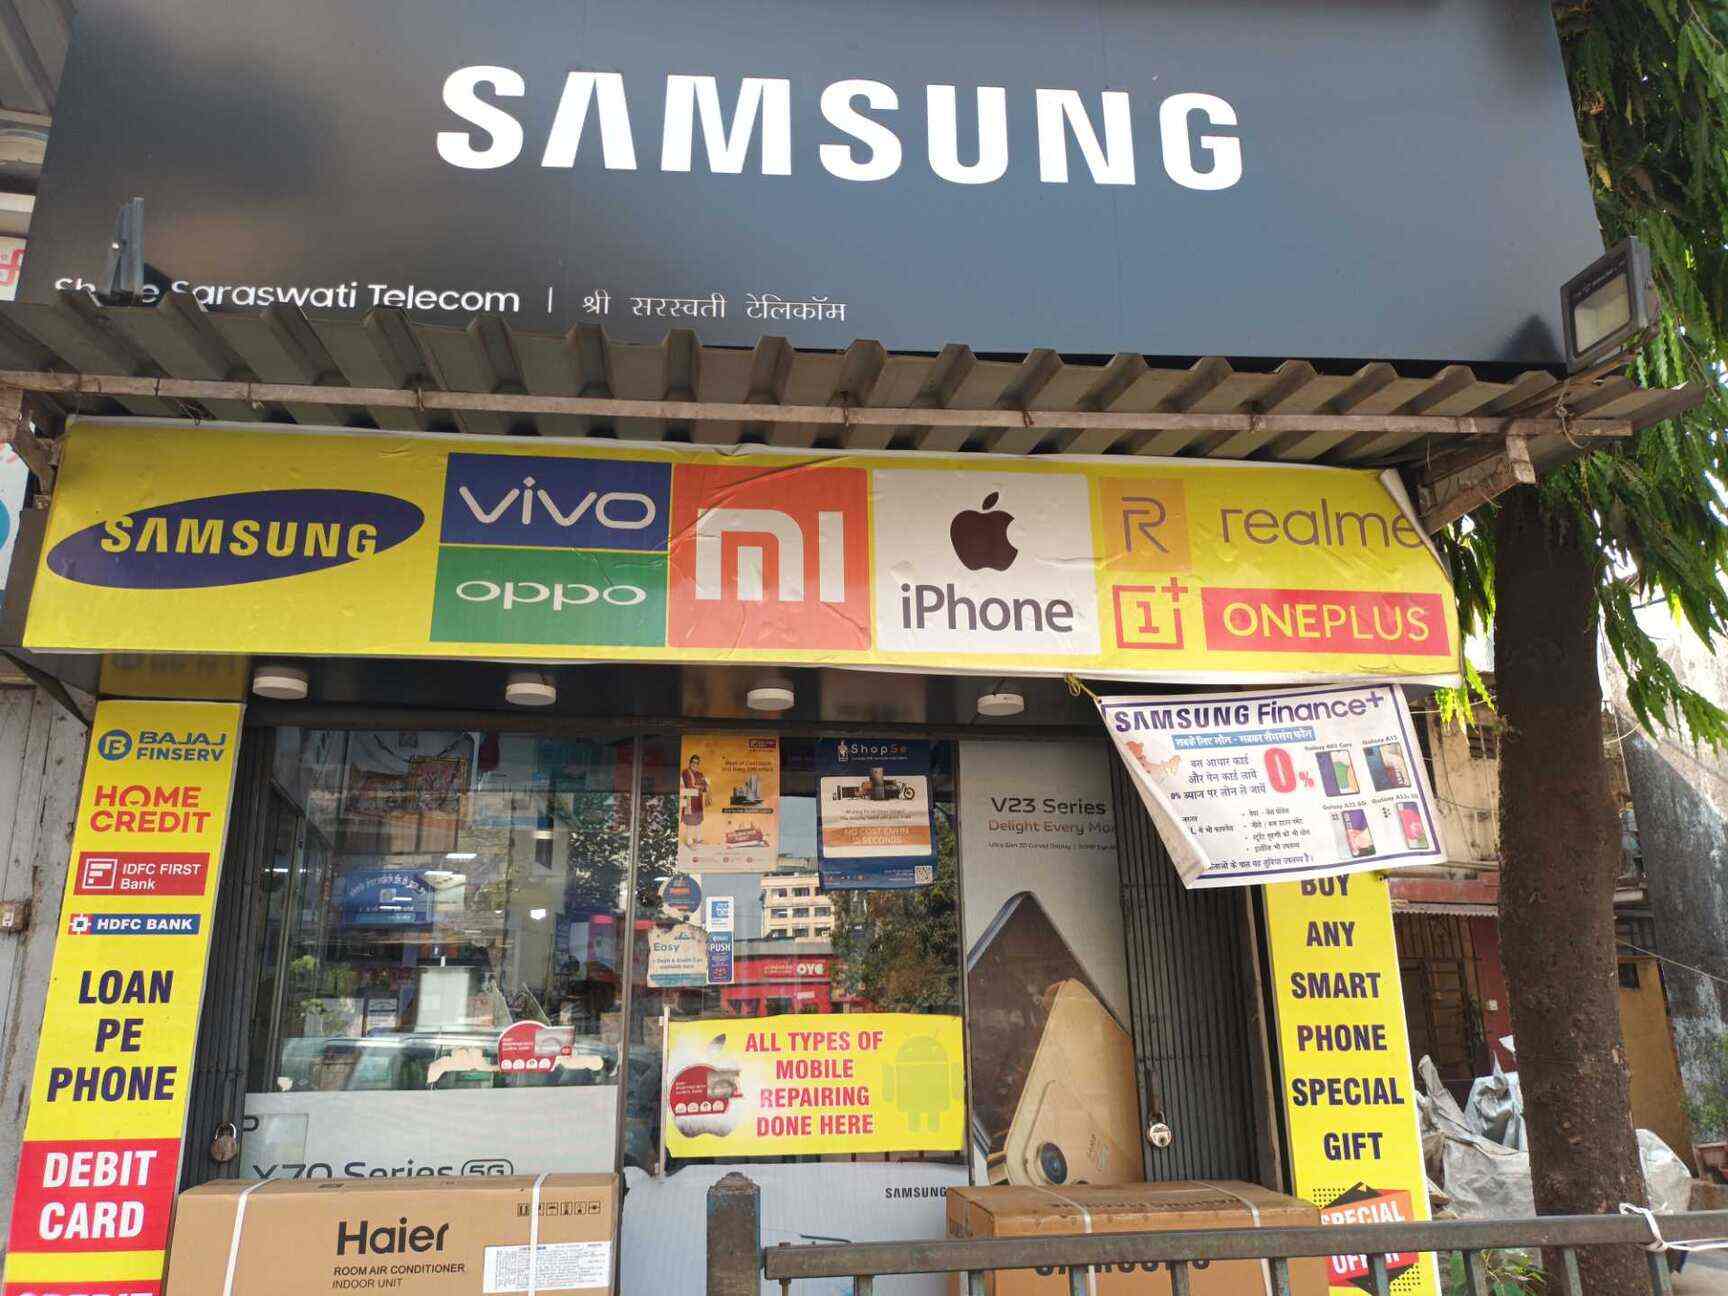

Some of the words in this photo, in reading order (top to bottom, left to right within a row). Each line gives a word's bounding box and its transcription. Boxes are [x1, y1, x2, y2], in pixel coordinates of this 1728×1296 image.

[436, 65, 1243, 191] SAMSUNG
[369, 284, 520, 312] Telecom
[582, 289, 610, 316] श्री
[630, 294, 727, 318] सरस्वती
[746, 293, 847, 322] टेलिकॉम
[458, 476, 656, 529] vivo
[101, 515, 377, 558] SAMSUNG
[1222, 498, 1424, 548] realme
[455, 581, 647, 611] oppo
[901, 584, 1075, 633] iPhone
[1222, 602, 1430, 642] ONEPLUS
[1115, 703, 1250, 733] SAMSUNG
[138, 730, 227, 745] BAJAJ
[136, 746, 225, 762] FINSERV
[94, 784, 202, 808] HOME
[990, 797, 1036, 813] V23
[1043, 798, 1107, 815] Series
[89, 810, 211, 833] CREDIT
[988, 819, 1040, 834] Delight
[1043, 820, 1084, 835] Every
[122, 862, 156, 875] IDFC
[160, 863, 201, 876] FIRST
[120, 877, 156, 890] Bank
[1301, 873, 1350, 896] BUY
[96, 918, 142, 930] HDFC
[146, 918, 193, 930] BANK
[1306, 921, 1356, 947] ANY
[78, 969, 174, 1004] LOAN
[1290, 972, 1381, 999] SMART
[94, 1018, 144, 1052] PE
[745, 1032, 781, 1052] ALL
[788, 1031, 850, 1052] TYPES
[858, 1031, 884, 1050] OF
[1297, 1024, 1388, 1052] PHONE
[776, 1059, 854, 1079] MOBILE
[46, 1066, 177, 1102] PHONE
[759, 1087, 869, 1108] REPAIRING
[1292, 1077, 1405, 1106] SPECIAL
[756, 1115, 812, 1136] DONE
[819, 1114, 874, 1134] HERE
[1323, 1132, 1383, 1161] GIFT
[42, 1150, 158, 1189] DEBIT
[885, 1186, 947, 1199] SAMSUNG
[38, 1200, 145, 1240] CARD
[336, 1216, 450, 1255] Haier
[333, 1266, 368, 1276] ROOM
[369, 1266, 388, 1275] AIR
[390, 1263, 466, 1274] CONDITIONER
[331, 1280, 375, 1289] INDOOR
[378, 1278, 403, 1288] UNIT
